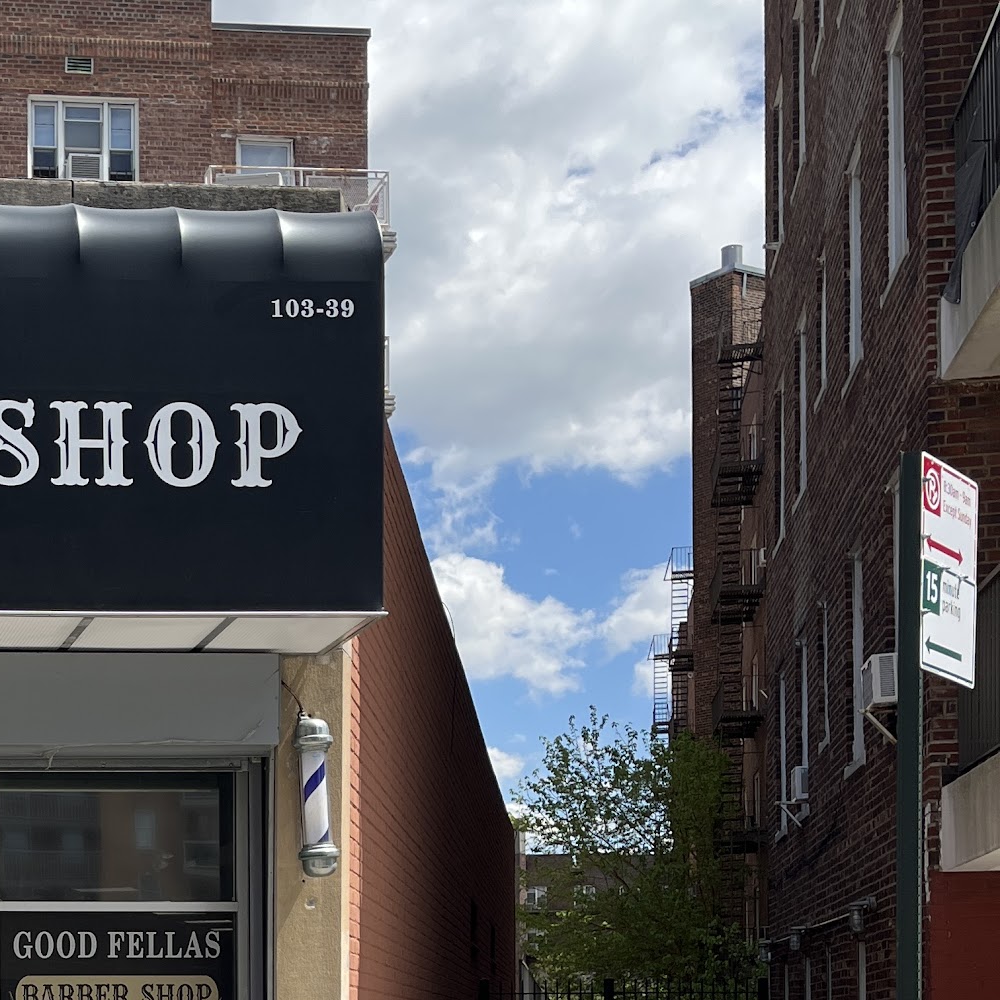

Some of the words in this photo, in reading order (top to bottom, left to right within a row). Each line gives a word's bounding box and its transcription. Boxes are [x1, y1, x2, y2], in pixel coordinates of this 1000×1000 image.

[271, 299, 355, 318] 103-39
[926, 571, 938, 603] 15
[13, 930, 98, 959] GOOD
[107, 930, 221, 959] FELLAS
